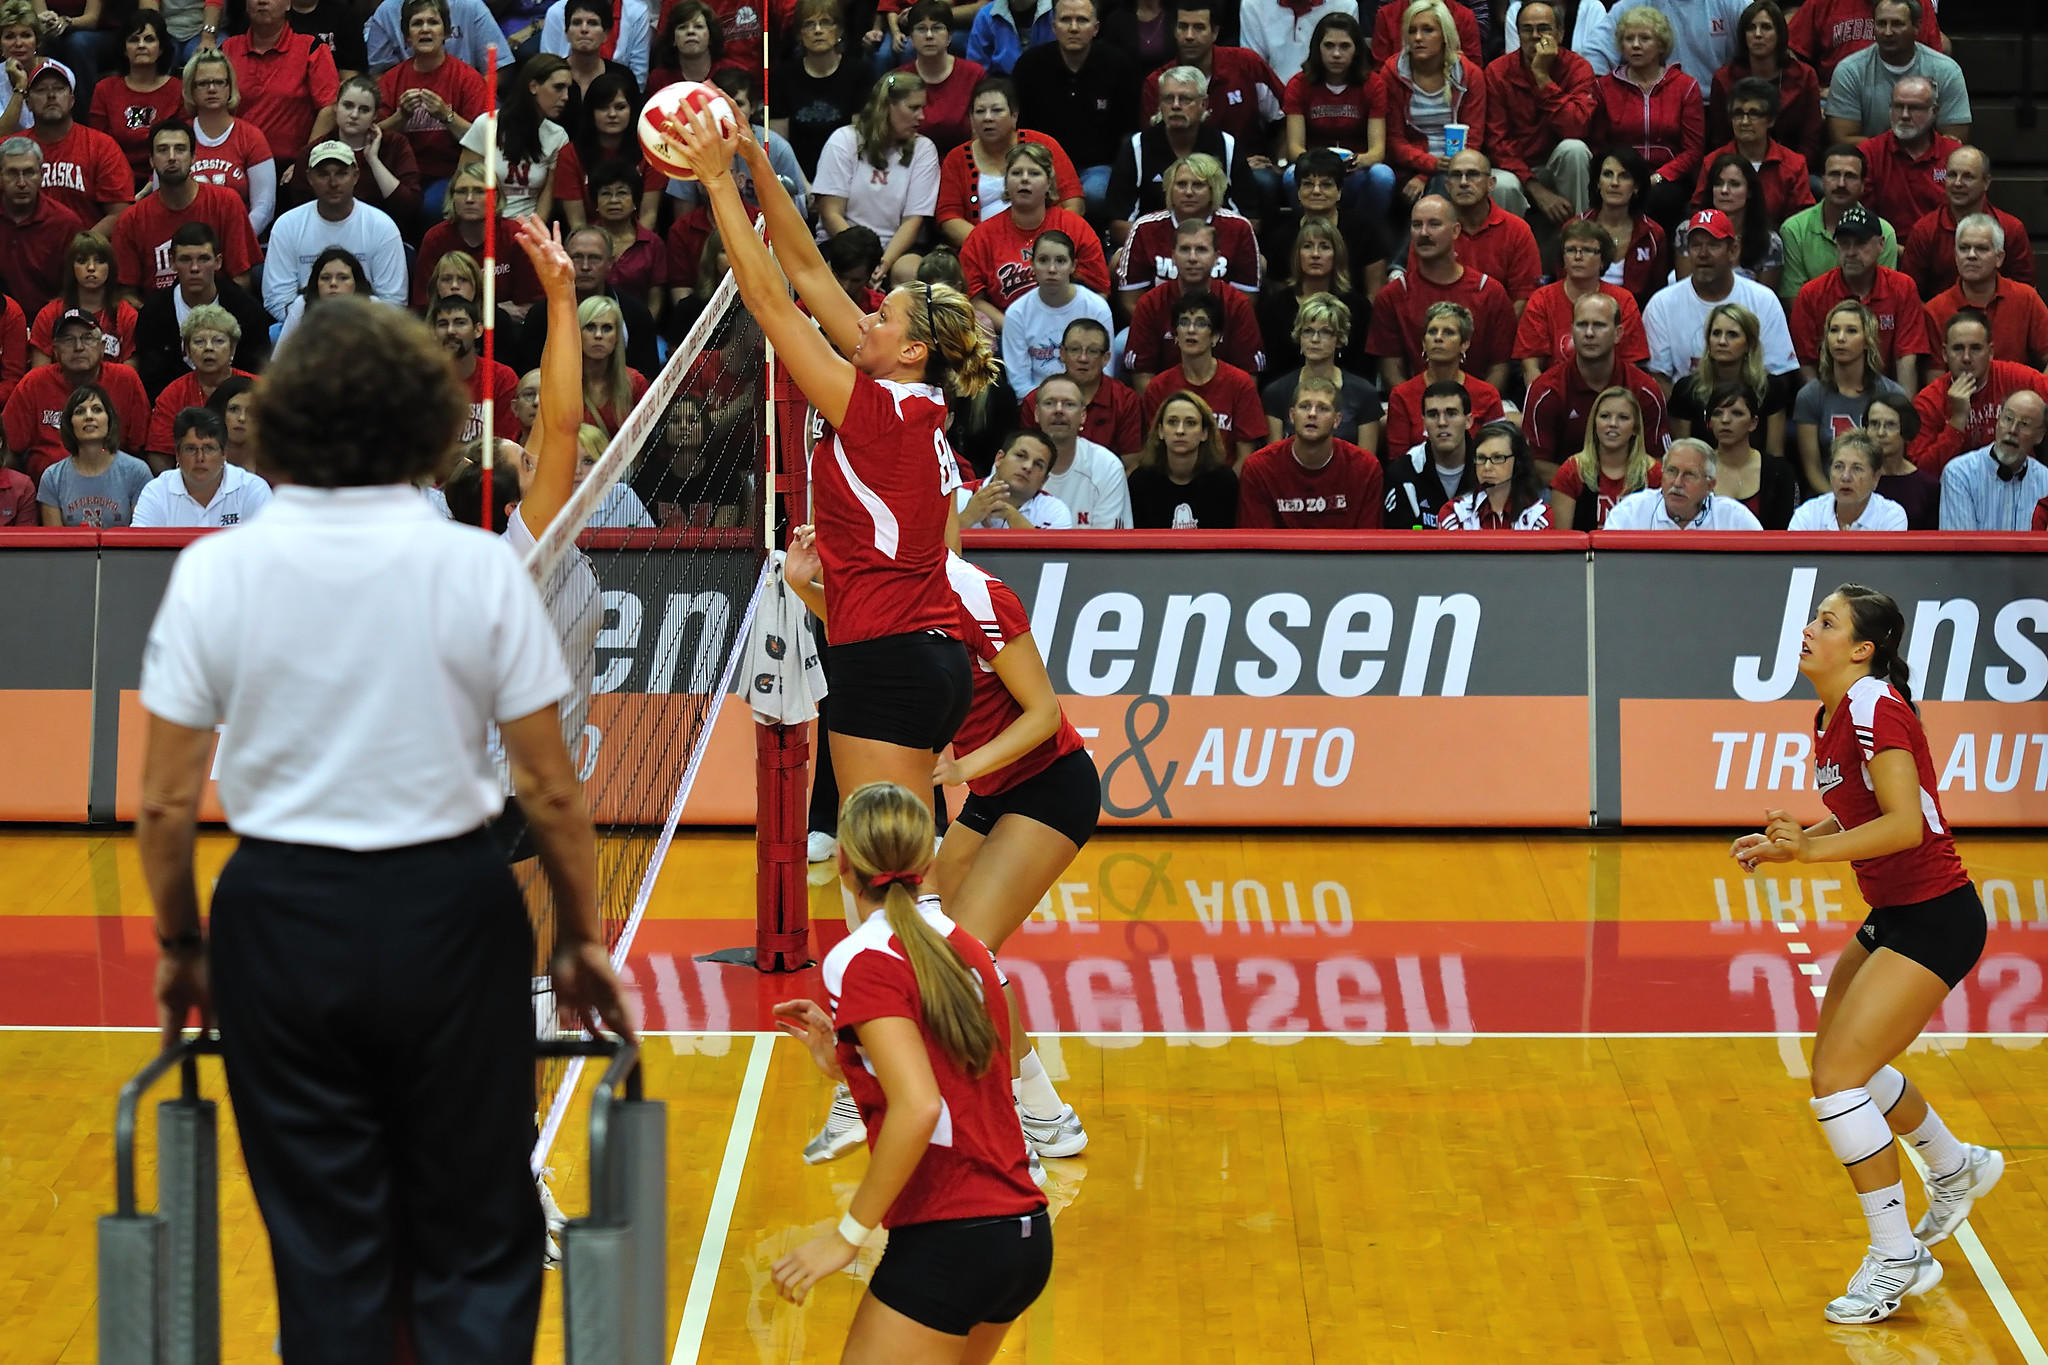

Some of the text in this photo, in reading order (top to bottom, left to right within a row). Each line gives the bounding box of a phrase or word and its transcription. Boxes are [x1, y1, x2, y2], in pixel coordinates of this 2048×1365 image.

[1712, 19, 1725, 32] N
[1228, 90, 1243, 105] N
[504, 161, 531, 186] N
[870, 169, 890, 185] N
[1699, 211, 1713, 224] N
[1637, 247, 1650, 261] N
[1277, 495, 1347, 512] RED ZOE
[1078, 512, 1089, 525] N
[1733, 568, 2048, 702] Jns
[1100, 694, 1355, 818] & AUTO
[1711, 732, 1818, 791] TIR
